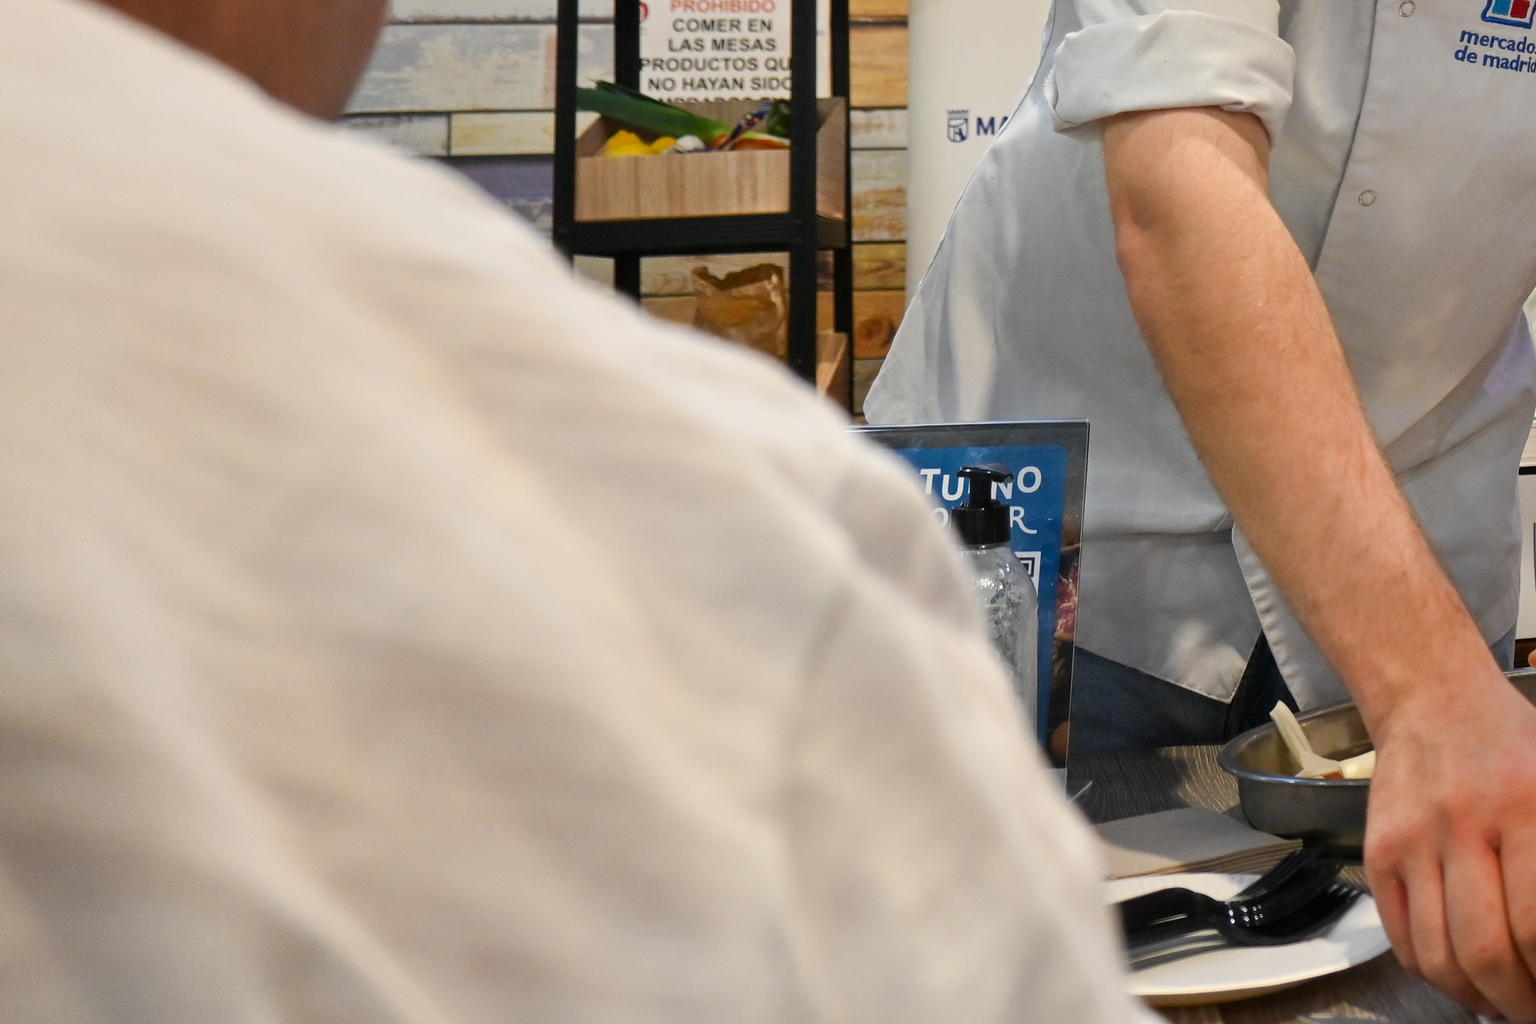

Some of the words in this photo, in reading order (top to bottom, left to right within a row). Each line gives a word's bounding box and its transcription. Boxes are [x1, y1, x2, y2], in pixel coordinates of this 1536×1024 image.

[670, 0, 776, 14] PROHIBIDO
[672, 18, 741, 33] COMER
[748, 19, 773, 32] EN
[668, 38, 704, 52] LAS
[711, 38, 776, 52] MESAS
[1454, 46, 1478, 63] de
[641, 58, 758, 72] PRODUCTOS
[649, 78, 675, 92] NO
[682, 77, 744, 91] HAYAN
[920, 466, 1042, 501] TUNO
